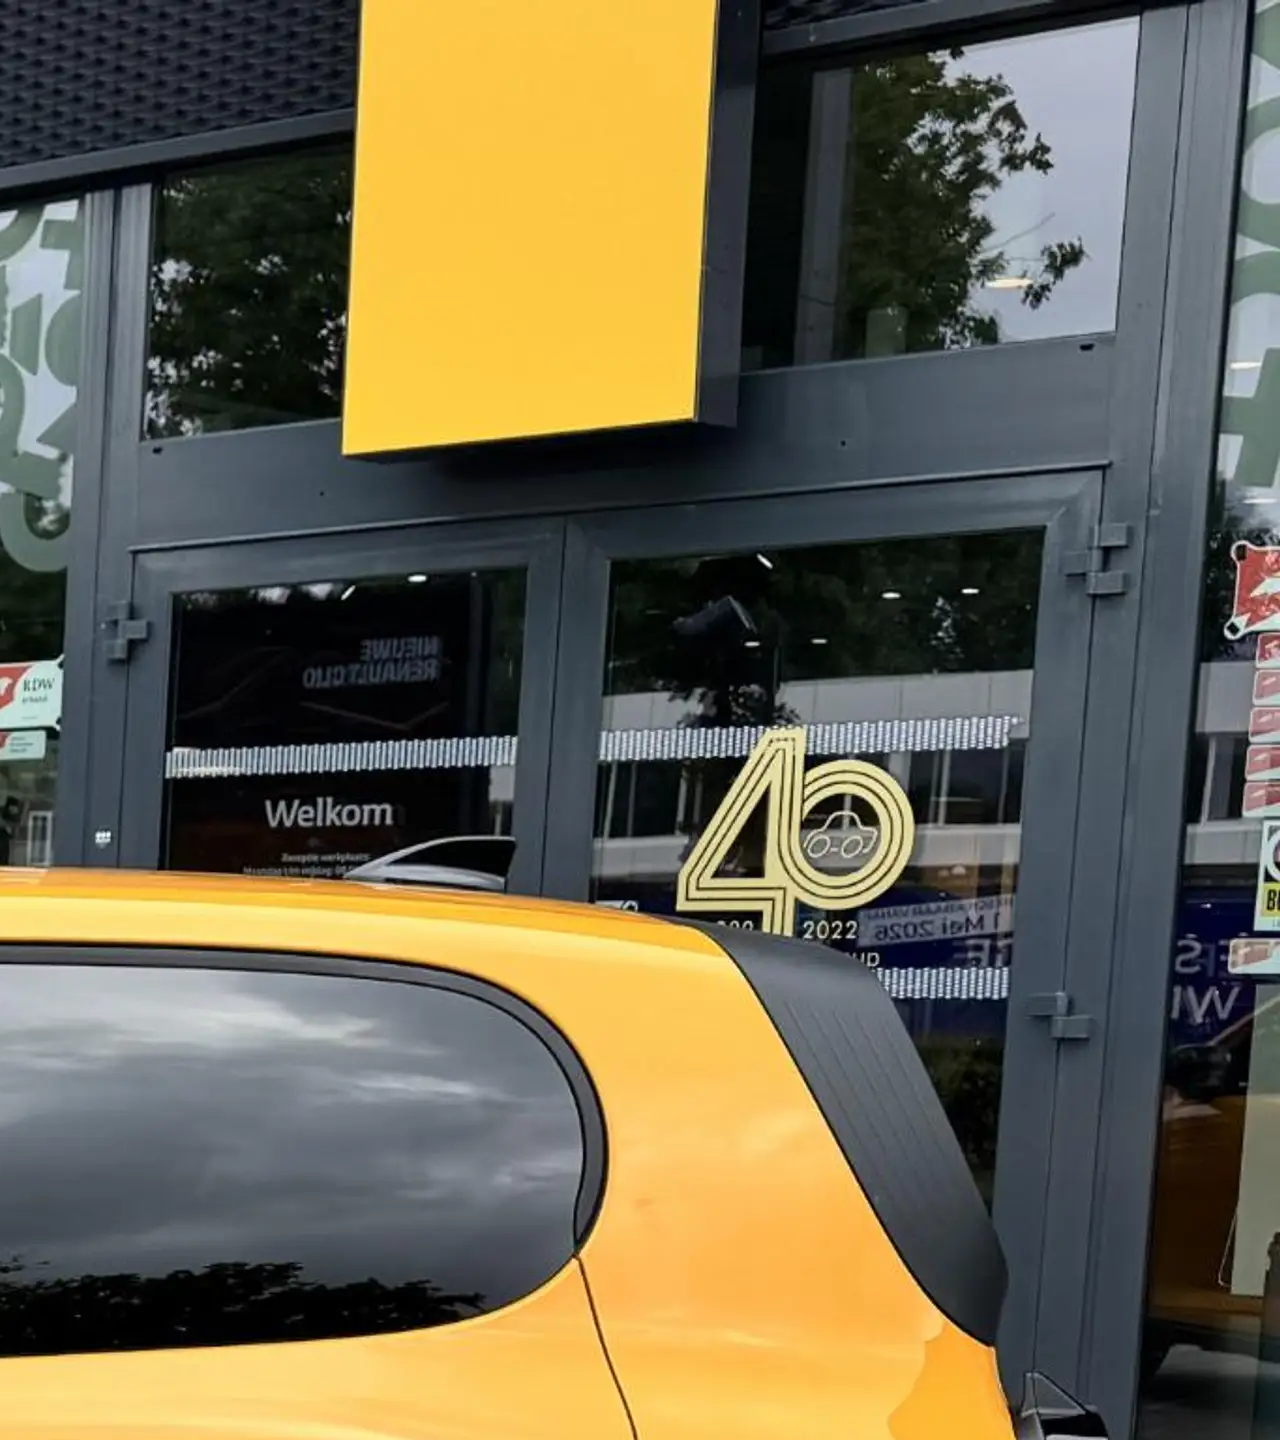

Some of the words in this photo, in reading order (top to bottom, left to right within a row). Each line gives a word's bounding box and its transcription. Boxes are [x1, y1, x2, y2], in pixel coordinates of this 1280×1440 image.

[23, 678, 56, 692] RDW
[264, 797, 394, 828] Welkom
[803, 920, 858, 939] 2022
